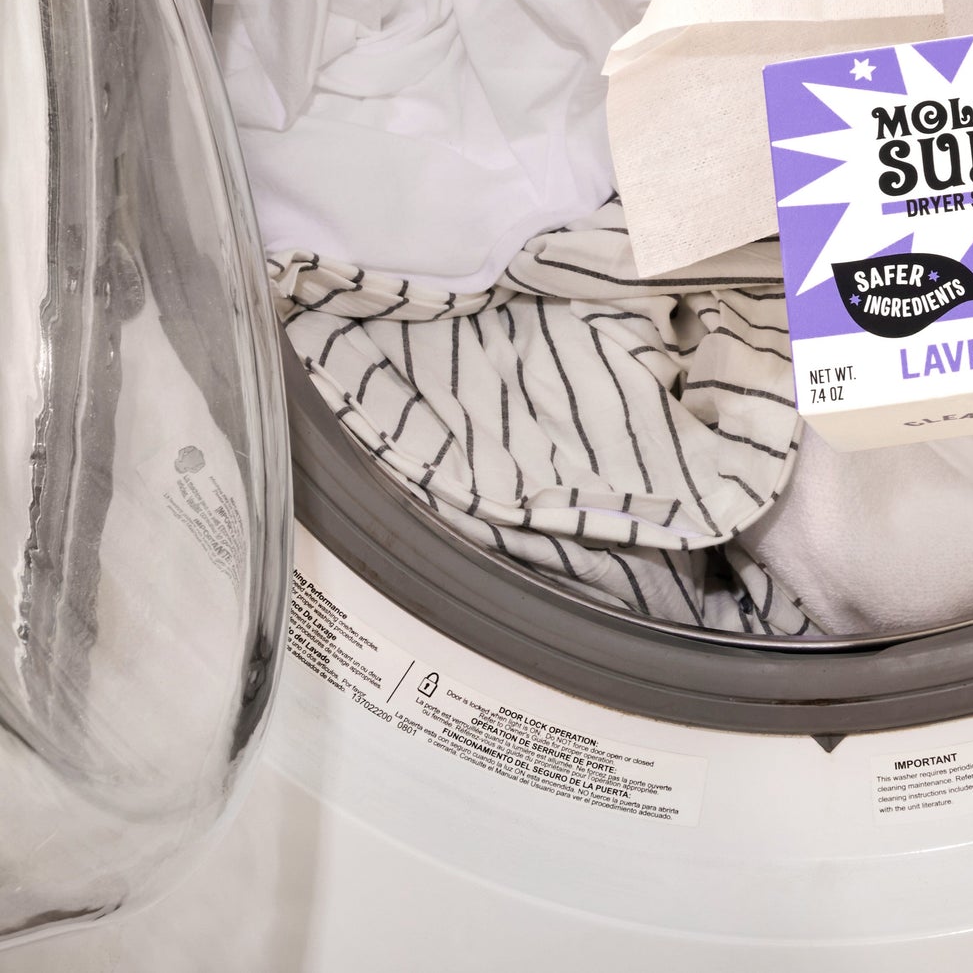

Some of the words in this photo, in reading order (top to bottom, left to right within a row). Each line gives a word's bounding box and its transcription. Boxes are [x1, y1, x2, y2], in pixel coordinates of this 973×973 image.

[906, 193, 965, 217] DRYER
[853, 264, 925, 292] SAFER
[863, 278, 966, 318] INGREDIENTS
[809, 368, 833, 385] NET
[835, 365, 857, 382] WT.
[810, 387, 827, 404] 7.4
[830, 385, 845, 402] OZ
[306, 583, 347, 619] Performance
[302, 610, 313, 621] De
[312, 618, 337, 641] Lavage
[305, 642, 330, 664] Lavado
[352, 693, 393, 722] 137022200
[397, 721, 417, 736] 0801
[498, 706, 523, 722] DOOR
[524, 717, 548, 731] LOCK
[548, 726, 598, 747] OPERATION:
[471, 717, 518, 742] OPÉRATION
[518, 738, 531, 748] DE
[531, 743, 574, 762] SERRURE
[572, 756, 585, 766] DE
[586, 760, 617, 775] PORTE:
[442, 727, 514, 764] FUNCIONAMIENTO
[514, 759, 530, 771] DEL
[532, 766, 568, 782] SEGURO
[569, 777, 581, 787] DE
[582, 781, 593, 790] LA
[595, 784, 631, 798] PUERTA:
[894, 753, 957, 770] IMPORTANT
[877, 785, 907, 793] cleaning
[955, 774, 973, 782] Refer
[893, 773, 918, 781] washer
[919, 769, 948, 778] requires
[878, 795, 907, 803] cleaning
[908, 790, 947, 799] instructions
[907, 803, 921, 811] unit
